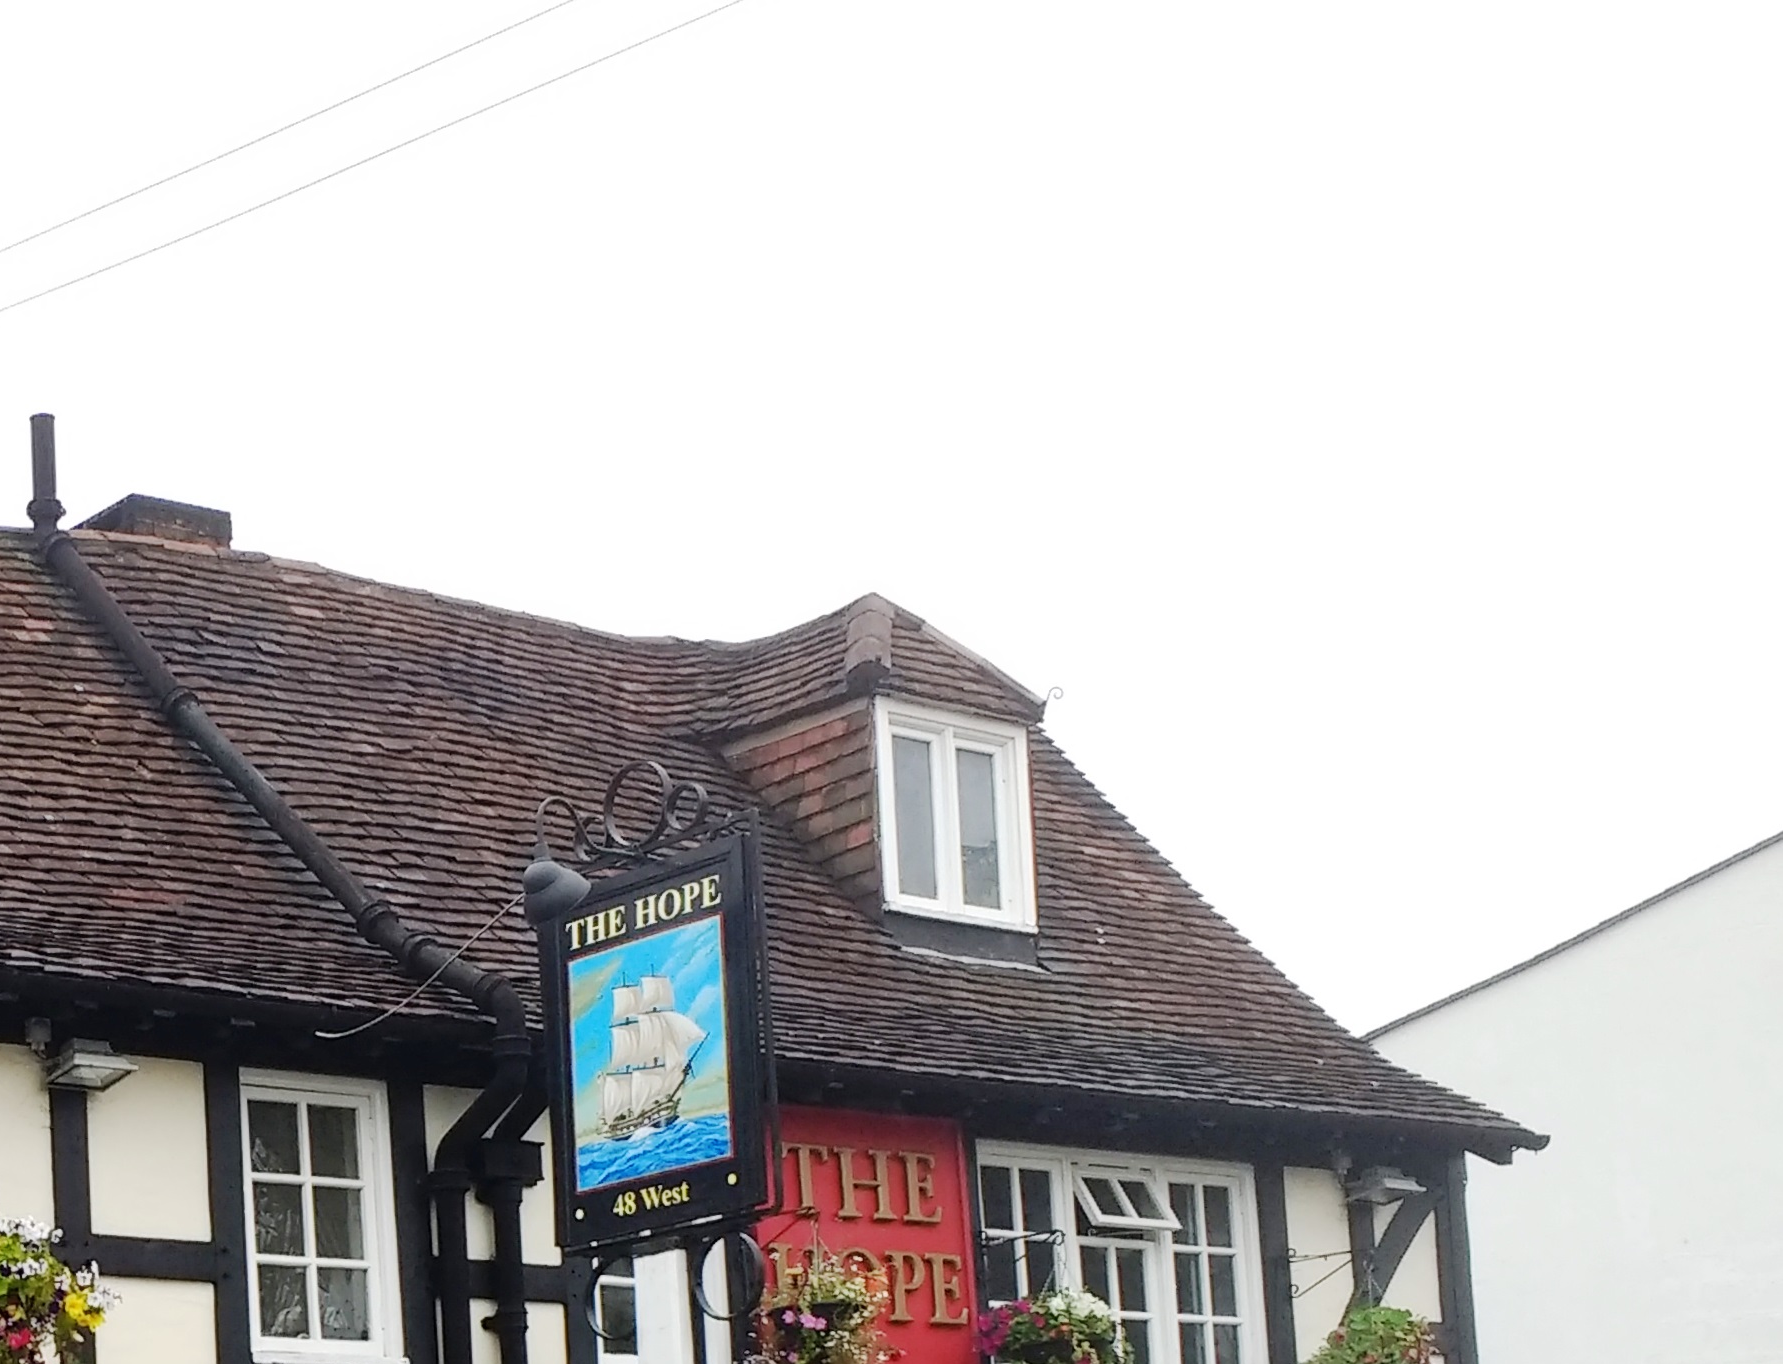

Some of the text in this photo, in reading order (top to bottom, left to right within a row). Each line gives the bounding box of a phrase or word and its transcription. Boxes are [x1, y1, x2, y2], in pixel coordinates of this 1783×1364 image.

[565, 874, 722, 951] THE HOPE
[612, 1180, 690, 1218] 48 West
[781, 1141, 942, 1225] THE
